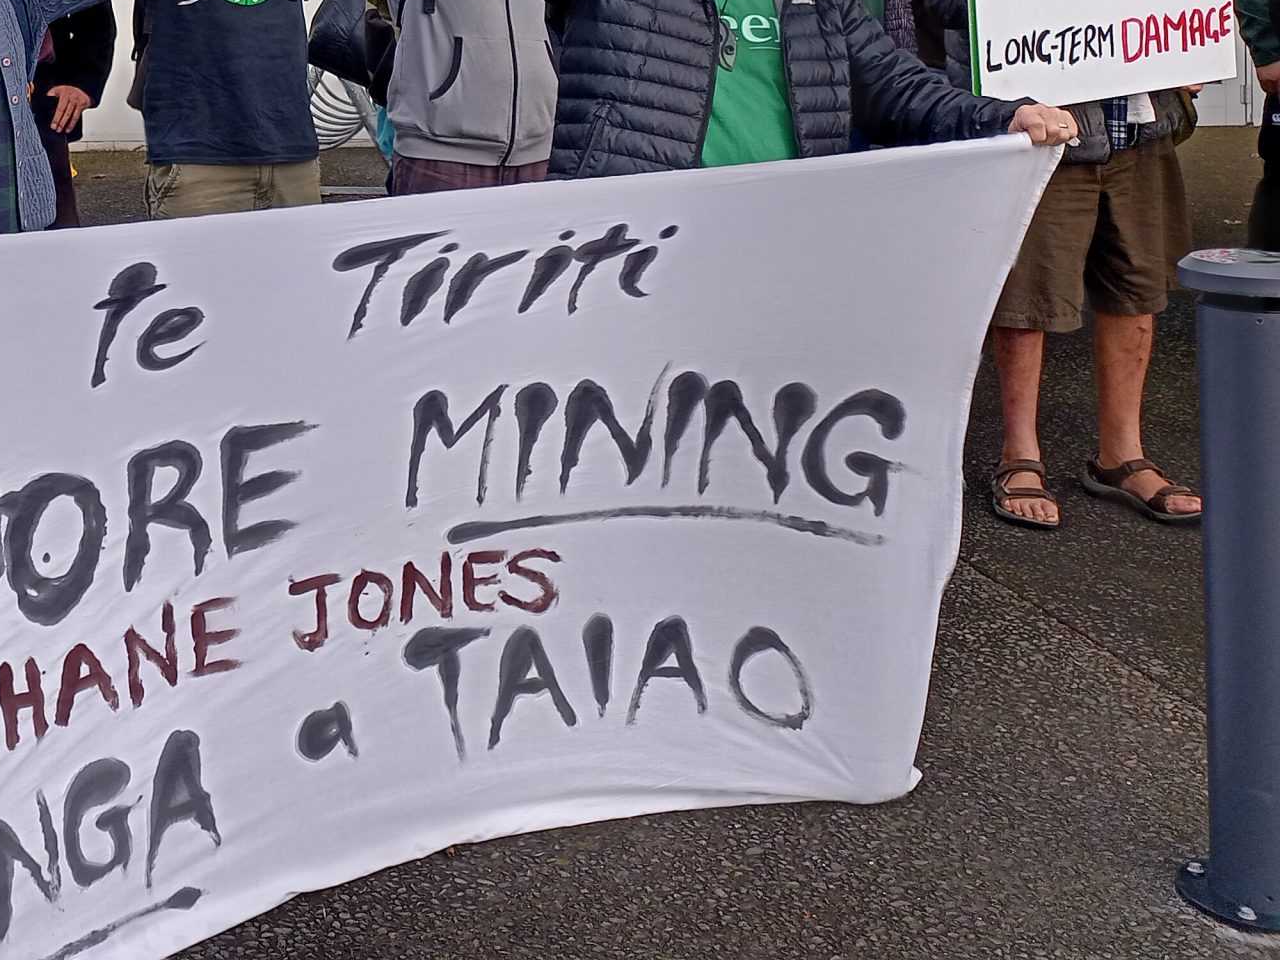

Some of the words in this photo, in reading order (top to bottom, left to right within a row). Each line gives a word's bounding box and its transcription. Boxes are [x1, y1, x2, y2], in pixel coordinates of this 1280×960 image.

[986, 24, 1115, 72] LONG-TERM
[1121, 1, 1232, 63] DAMAGE
[91, 261, 208, 389] te
[332, 223, 681, 341] Tiriti
[405, 365, 908, 518] MINING
[288, 548, 562, 652] JONES
[295, 699, 360, 761] a
[403, 612, 815, 760] TAIAO
